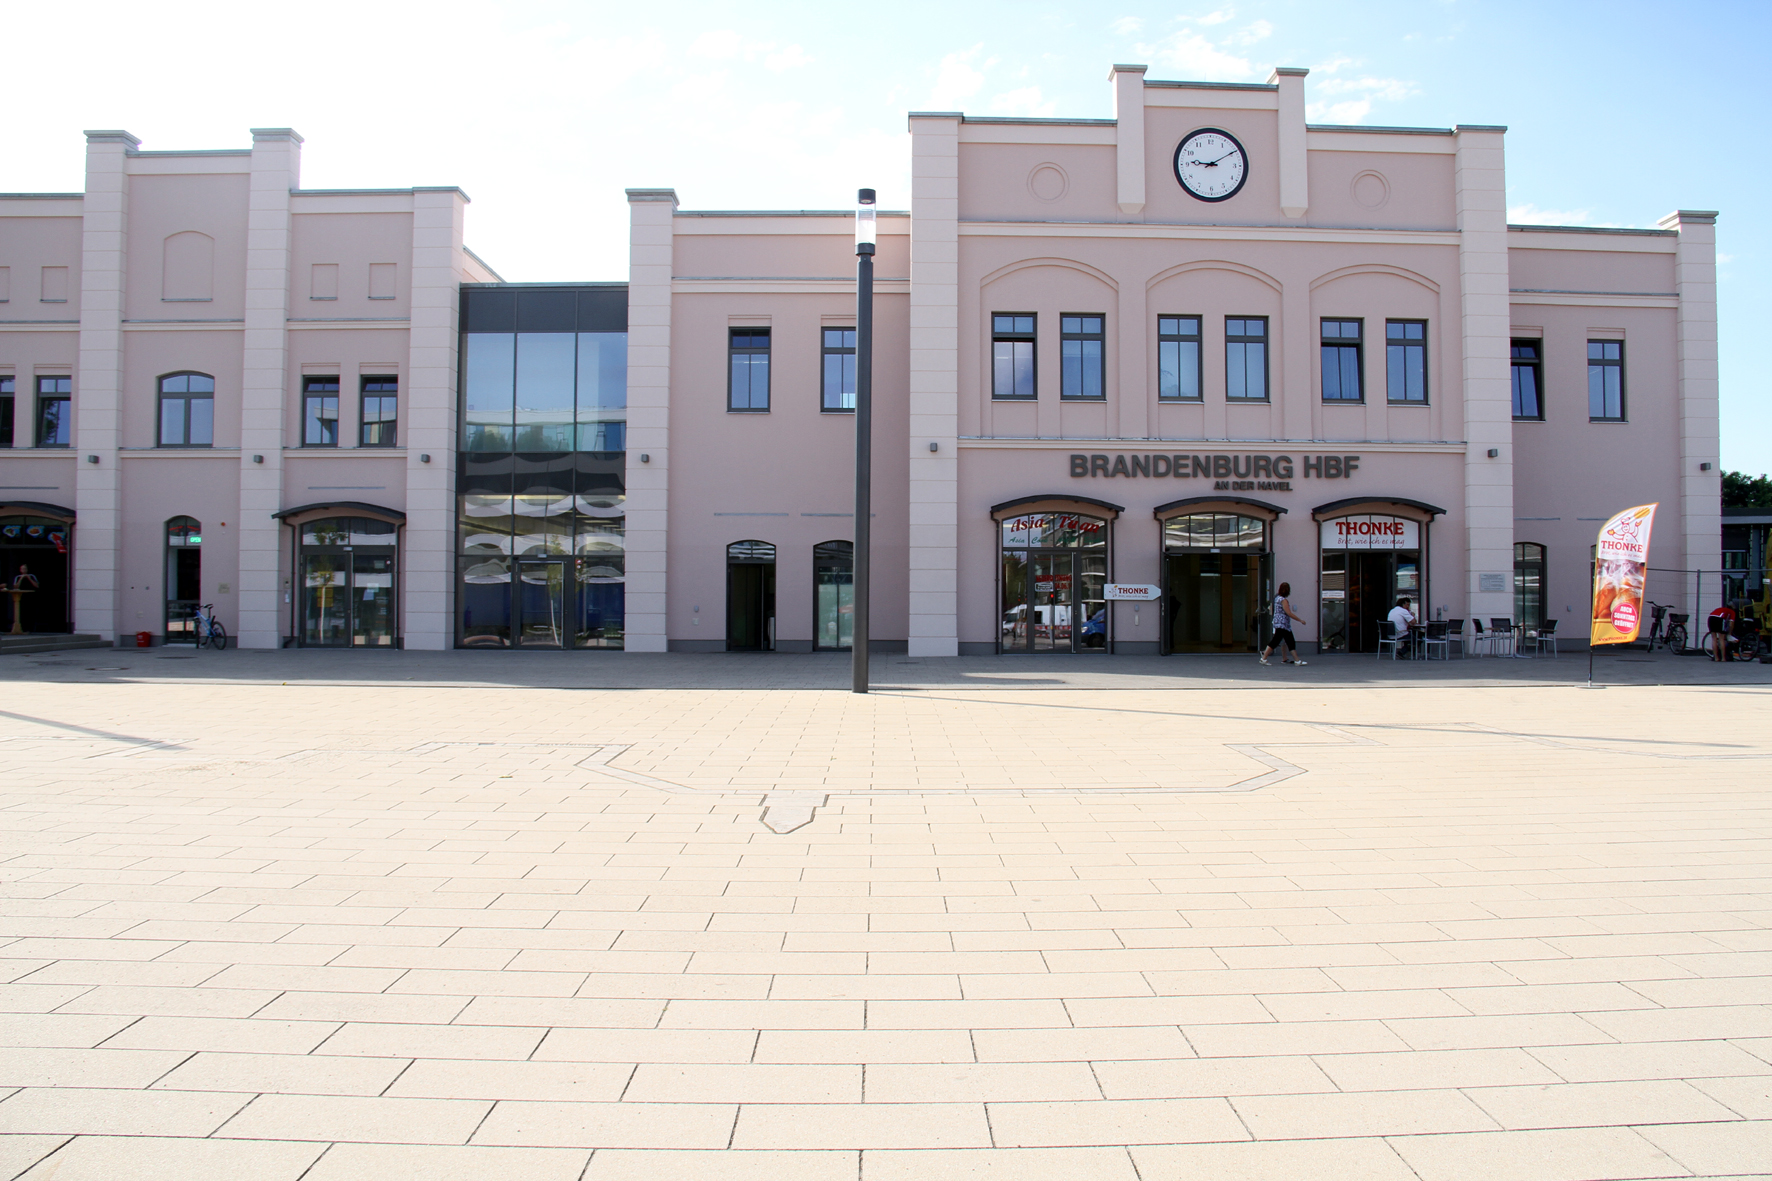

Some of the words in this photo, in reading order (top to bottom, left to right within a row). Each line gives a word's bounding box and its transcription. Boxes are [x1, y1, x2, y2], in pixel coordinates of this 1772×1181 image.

[1070, 454, 1293, 479] BRANDENBURG
[1304, 456, 1360, 479] HBF
[1214, 481, 1230, 490] AN
[1232, 481, 1254, 490] DER
[1258, 481, 1294, 492] HAVEL
[1011, 516, 1044, 532] Asia
[1059, 516, 1100, 533] Tuan
[1335, 522, 1404, 536] THONKE
[1601, 540, 1644, 552] THONKE
